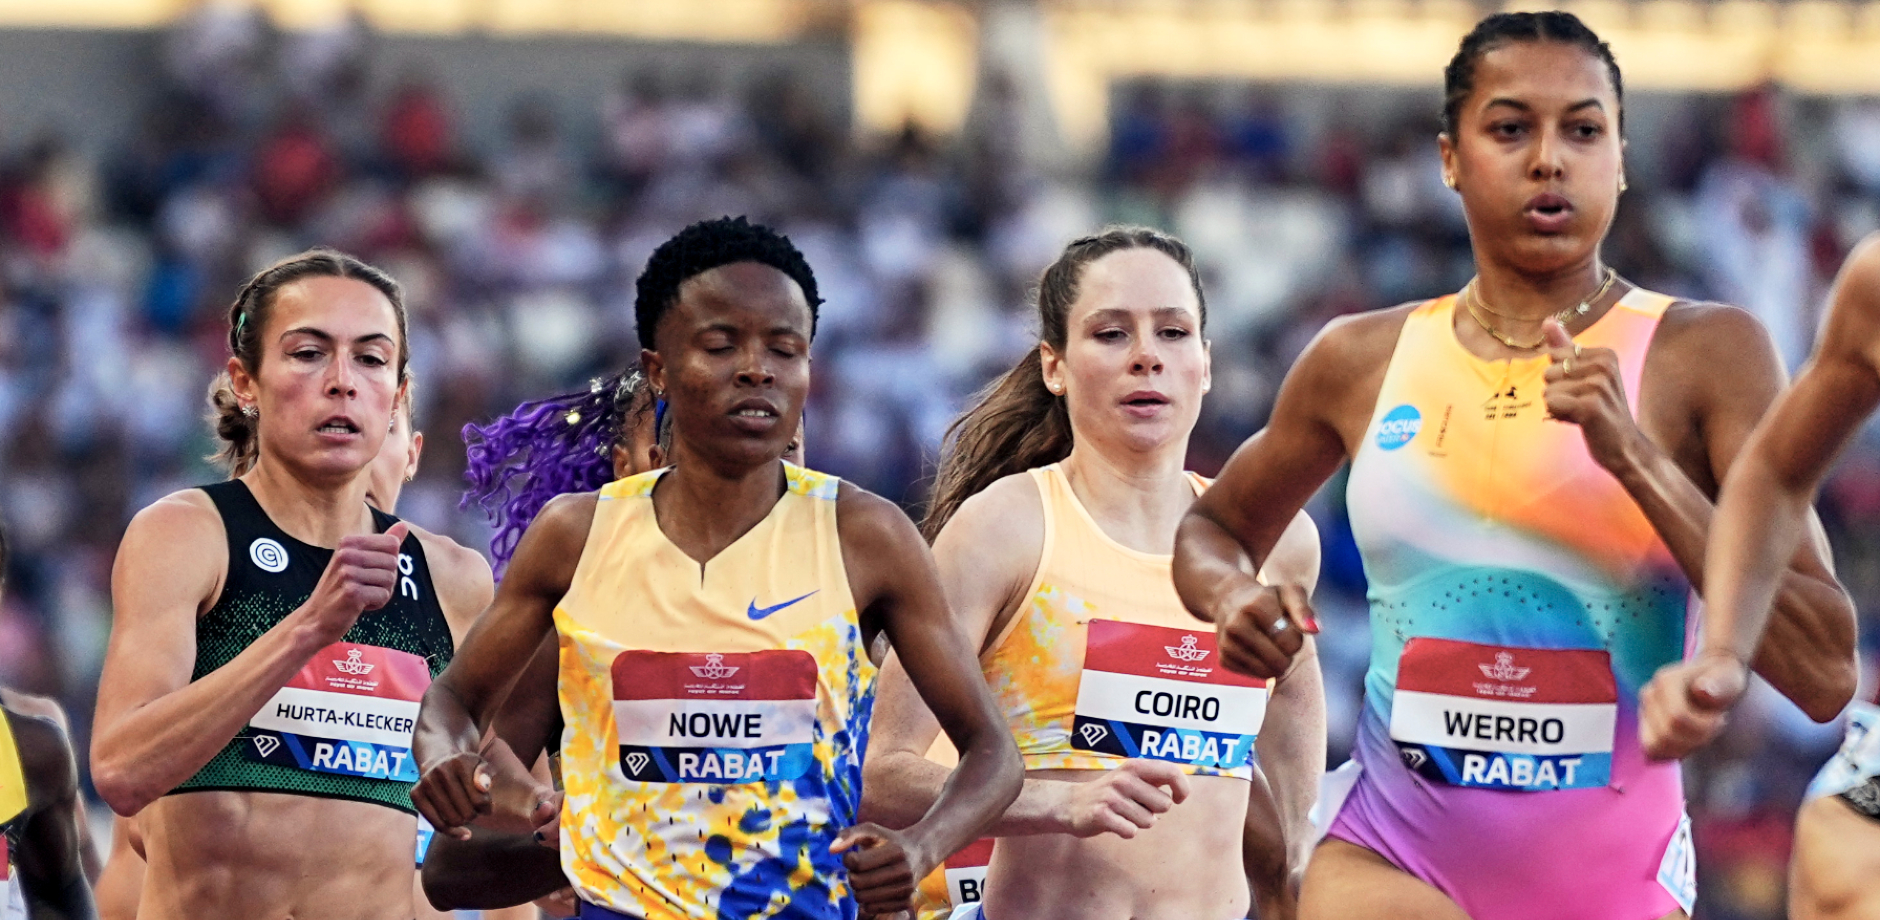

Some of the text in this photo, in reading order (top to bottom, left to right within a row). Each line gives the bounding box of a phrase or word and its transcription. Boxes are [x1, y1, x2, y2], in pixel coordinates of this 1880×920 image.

[275, 702, 413, 733] HURTA-KLECKER
[1134, 690, 1220, 721] COIRO
[668, 712, 762, 738] NOWE
[1443, 710, 1564, 744] WERRO
[313, 742, 407, 777] RABAT
[1140, 730, 1240, 763] RABAT
[678, 750, 786, 779] RABAT
[1462, 754, 1581, 786] RABAT
